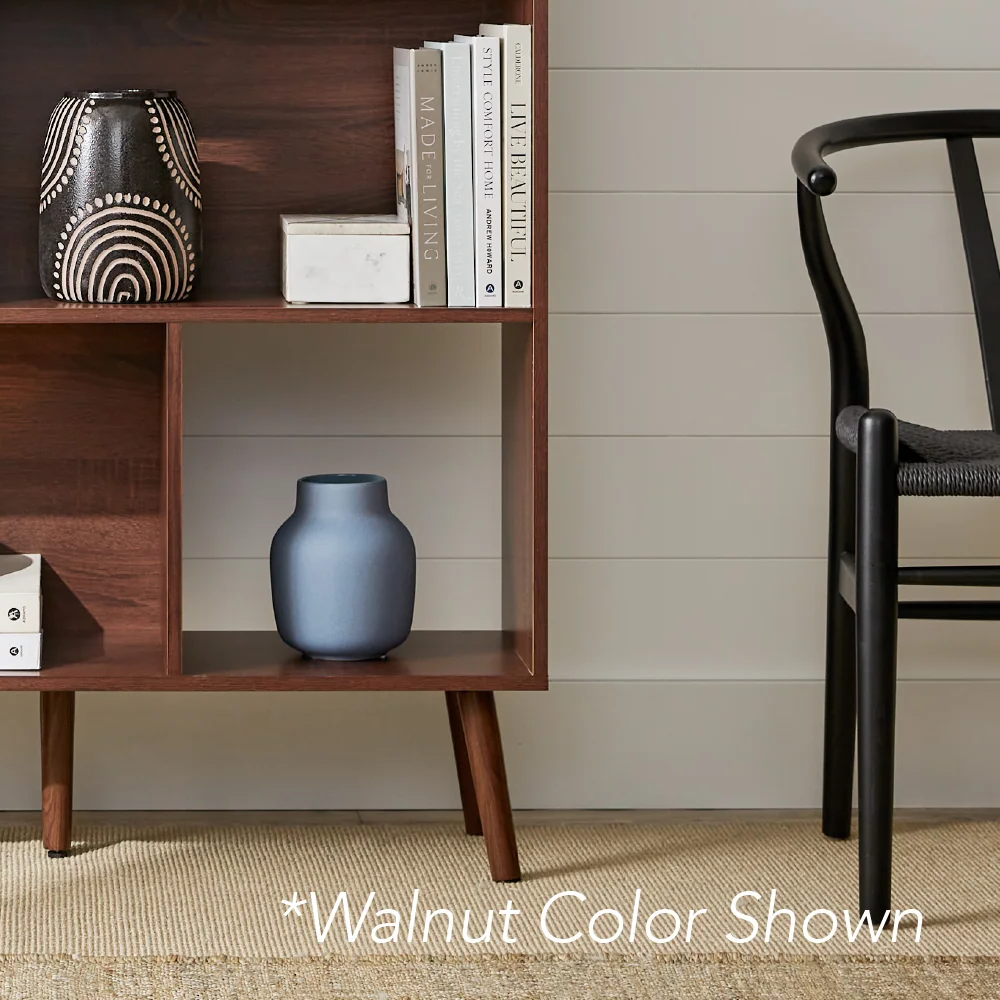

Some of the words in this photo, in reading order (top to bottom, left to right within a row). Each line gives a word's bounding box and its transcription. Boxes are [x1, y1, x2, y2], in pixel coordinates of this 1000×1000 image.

[482, 47, 492, 87] STYLE
[420, 96, 436, 160] MADE
[483, 91, 493, 155] COMFORT
[510, 103, 526, 147] LIVE
[484, 161, 494, 200] HOME
[510, 153, 527, 262] BEAUTIFUL
[423, 185, 439, 261] LIVING
